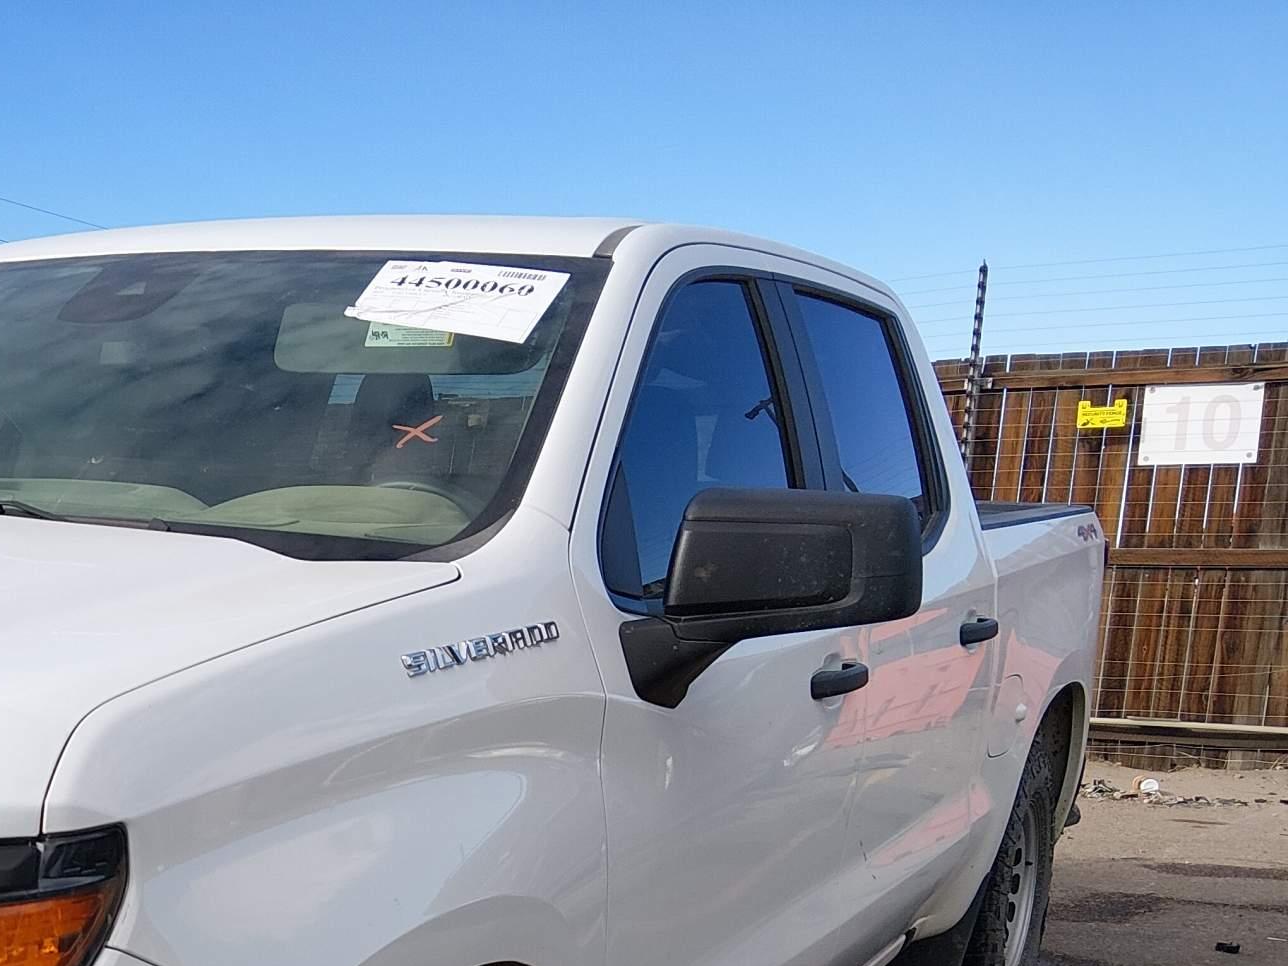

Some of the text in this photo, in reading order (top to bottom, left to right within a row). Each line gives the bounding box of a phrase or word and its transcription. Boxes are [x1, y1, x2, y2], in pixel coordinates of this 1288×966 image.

[390, 274, 535, 297] 44500060
[1166, 395, 1241, 450] 10
[401, 621, 560, 678] SILVERADO
